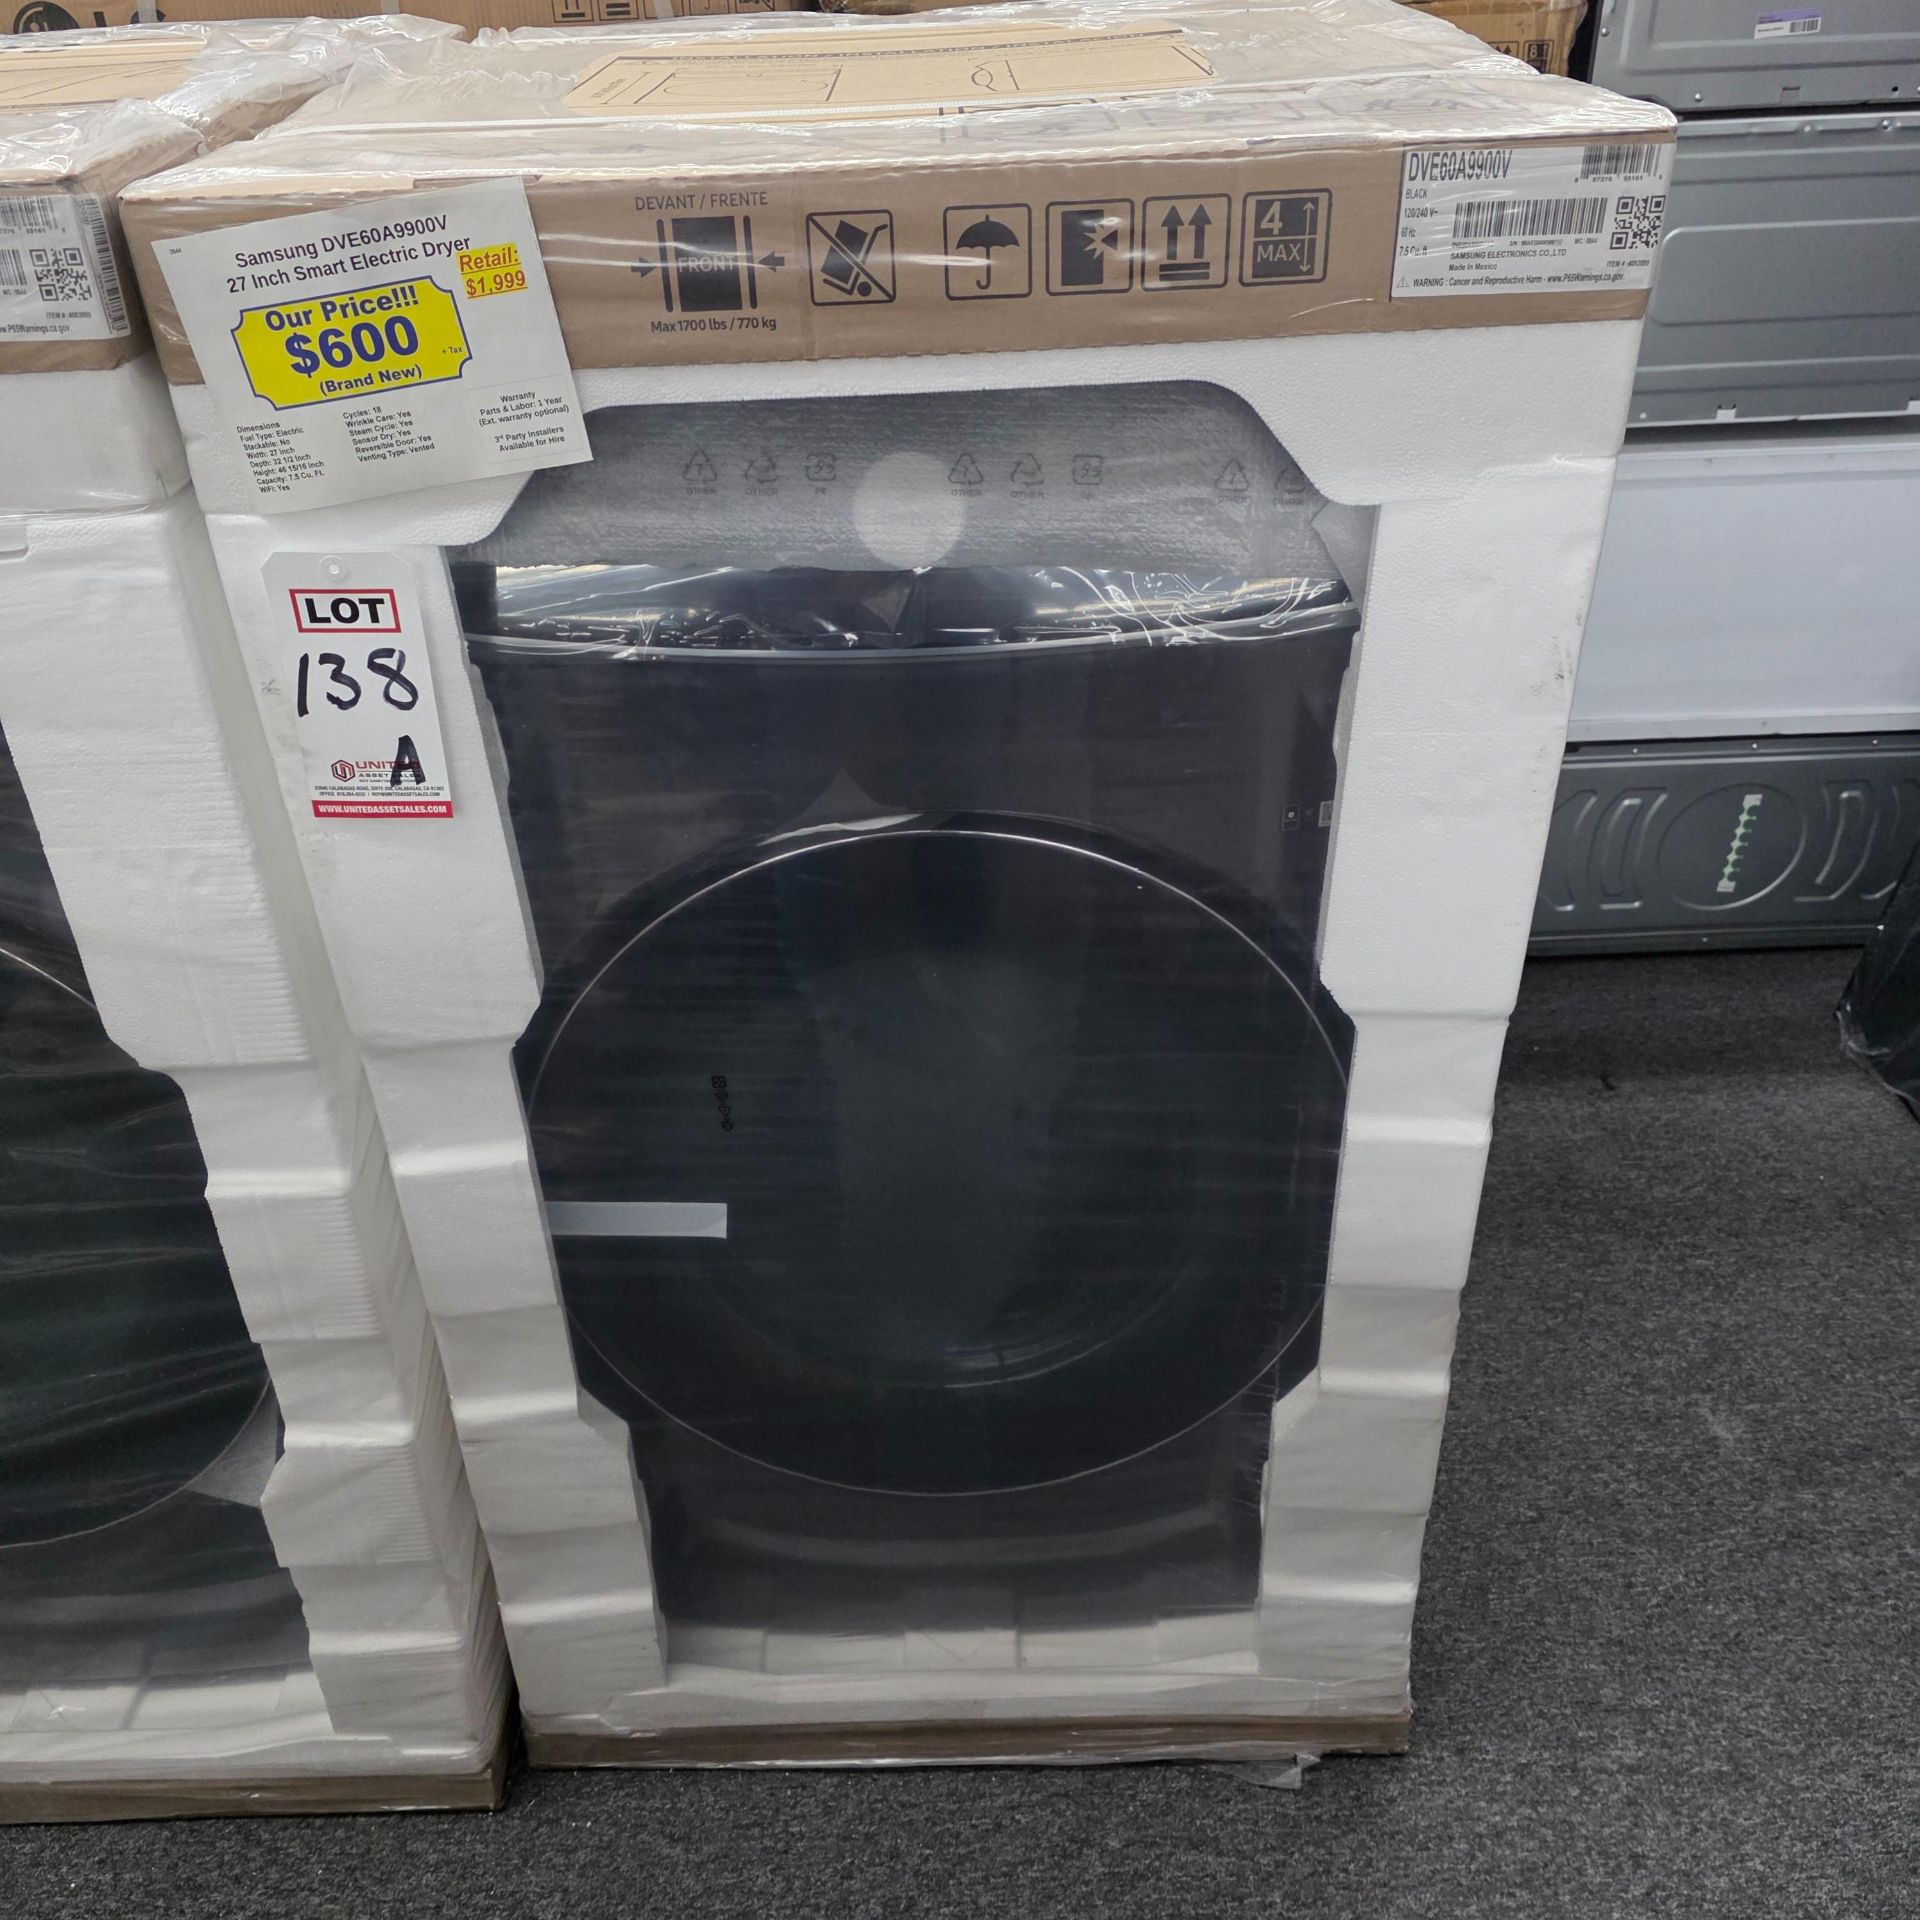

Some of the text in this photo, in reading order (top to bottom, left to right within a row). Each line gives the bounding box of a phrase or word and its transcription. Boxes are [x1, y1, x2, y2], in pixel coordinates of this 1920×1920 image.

[1408, 150, 1512, 181] DVE60A9900V
[635, 191, 769, 210] DEVANT / FRENTE
[1406, 188, 1428, 199] BLACK
[1260, 200, 1283, 235] 4
[1404, 207, 1428, 218] 120/240
[1409, 226, 1416, 237] Hz
[235, 214, 447, 268] Samsung DVE60A9900V
[459, 246, 520, 274] Retail:
[1257, 243, 1302, 263] MAX
[1450, 251, 1486, 260] SAMSUNG
[1487, 249, 1537, 258] ELECTRONICS
[227, 236, 470, 293] 27 Inch Smart Electric Dryer
[677, 255, 736, 273] FRONT
[466, 269, 527, 298] $1,999
[1413, 278, 1444, 287] WARNING
[1449, 277, 1470, 286] Cancer
[1472, 277, 1483, 285] and
[1485, 276, 1525, 286] Reproductive
[1526, 275, 1542, 284] Harm
[265, 285, 419, 332] Our Price!!!
[651, 316, 777, 333] Max 1700 lbs / 770 kg
[284, 315, 419, 378] $600
[448, 346, 463, 354] Tax
[319, 363, 422, 396] (Brand New)
[500, 391, 536, 403] Warranty
[343, 405, 382, 420] Cycles: 18
[480, 408, 501, 416] Parts
[510, 401, 537, 412] Labor:
[544, 396, 562, 405] Year
[345, 410, 411, 428] Wrinkle Care: Yes
[478, 404, 570, 427] (Ext. warranty optional)
[236, 421, 280, 433] Dimensions
[240, 427, 304, 442] Fuel Type: Electric
[349, 419, 413, 437] Steam Cycle: Yes
[505, 432, 526, 441] Party
[527, 426, 565, 437] Installers
[243, 440, 279, 451] Stackable:
[352, 429, 411, 445] Sensor Dry: Yes
[355, 434, 432, 454] Reversible Door: Yes
[499, 435, 565, 452] Available for Hire
[246, 451, 268, 459] Width:
[279, 447, 295, 455] Inch
[250, 460, 272, 468] Depth:
[295, 453, 311, 461] Inch
[357, 442, 435, 463] Venting Type: Vented
[253, 468, 277, 477] Height:
[308, 460, 325, 469] Inch
[256, 476, 288, 486] Capacity:
[288, 473, 300, 482] 7.5
[745, 487, 778, 496] OTHER
[304, 597, 385, 624] LOT
[296, 647, 419, 718] 138
[390, 734, 427, 787] A
[318, 804, 447, 814] WWW.UNITEDASSETSALES.COM
